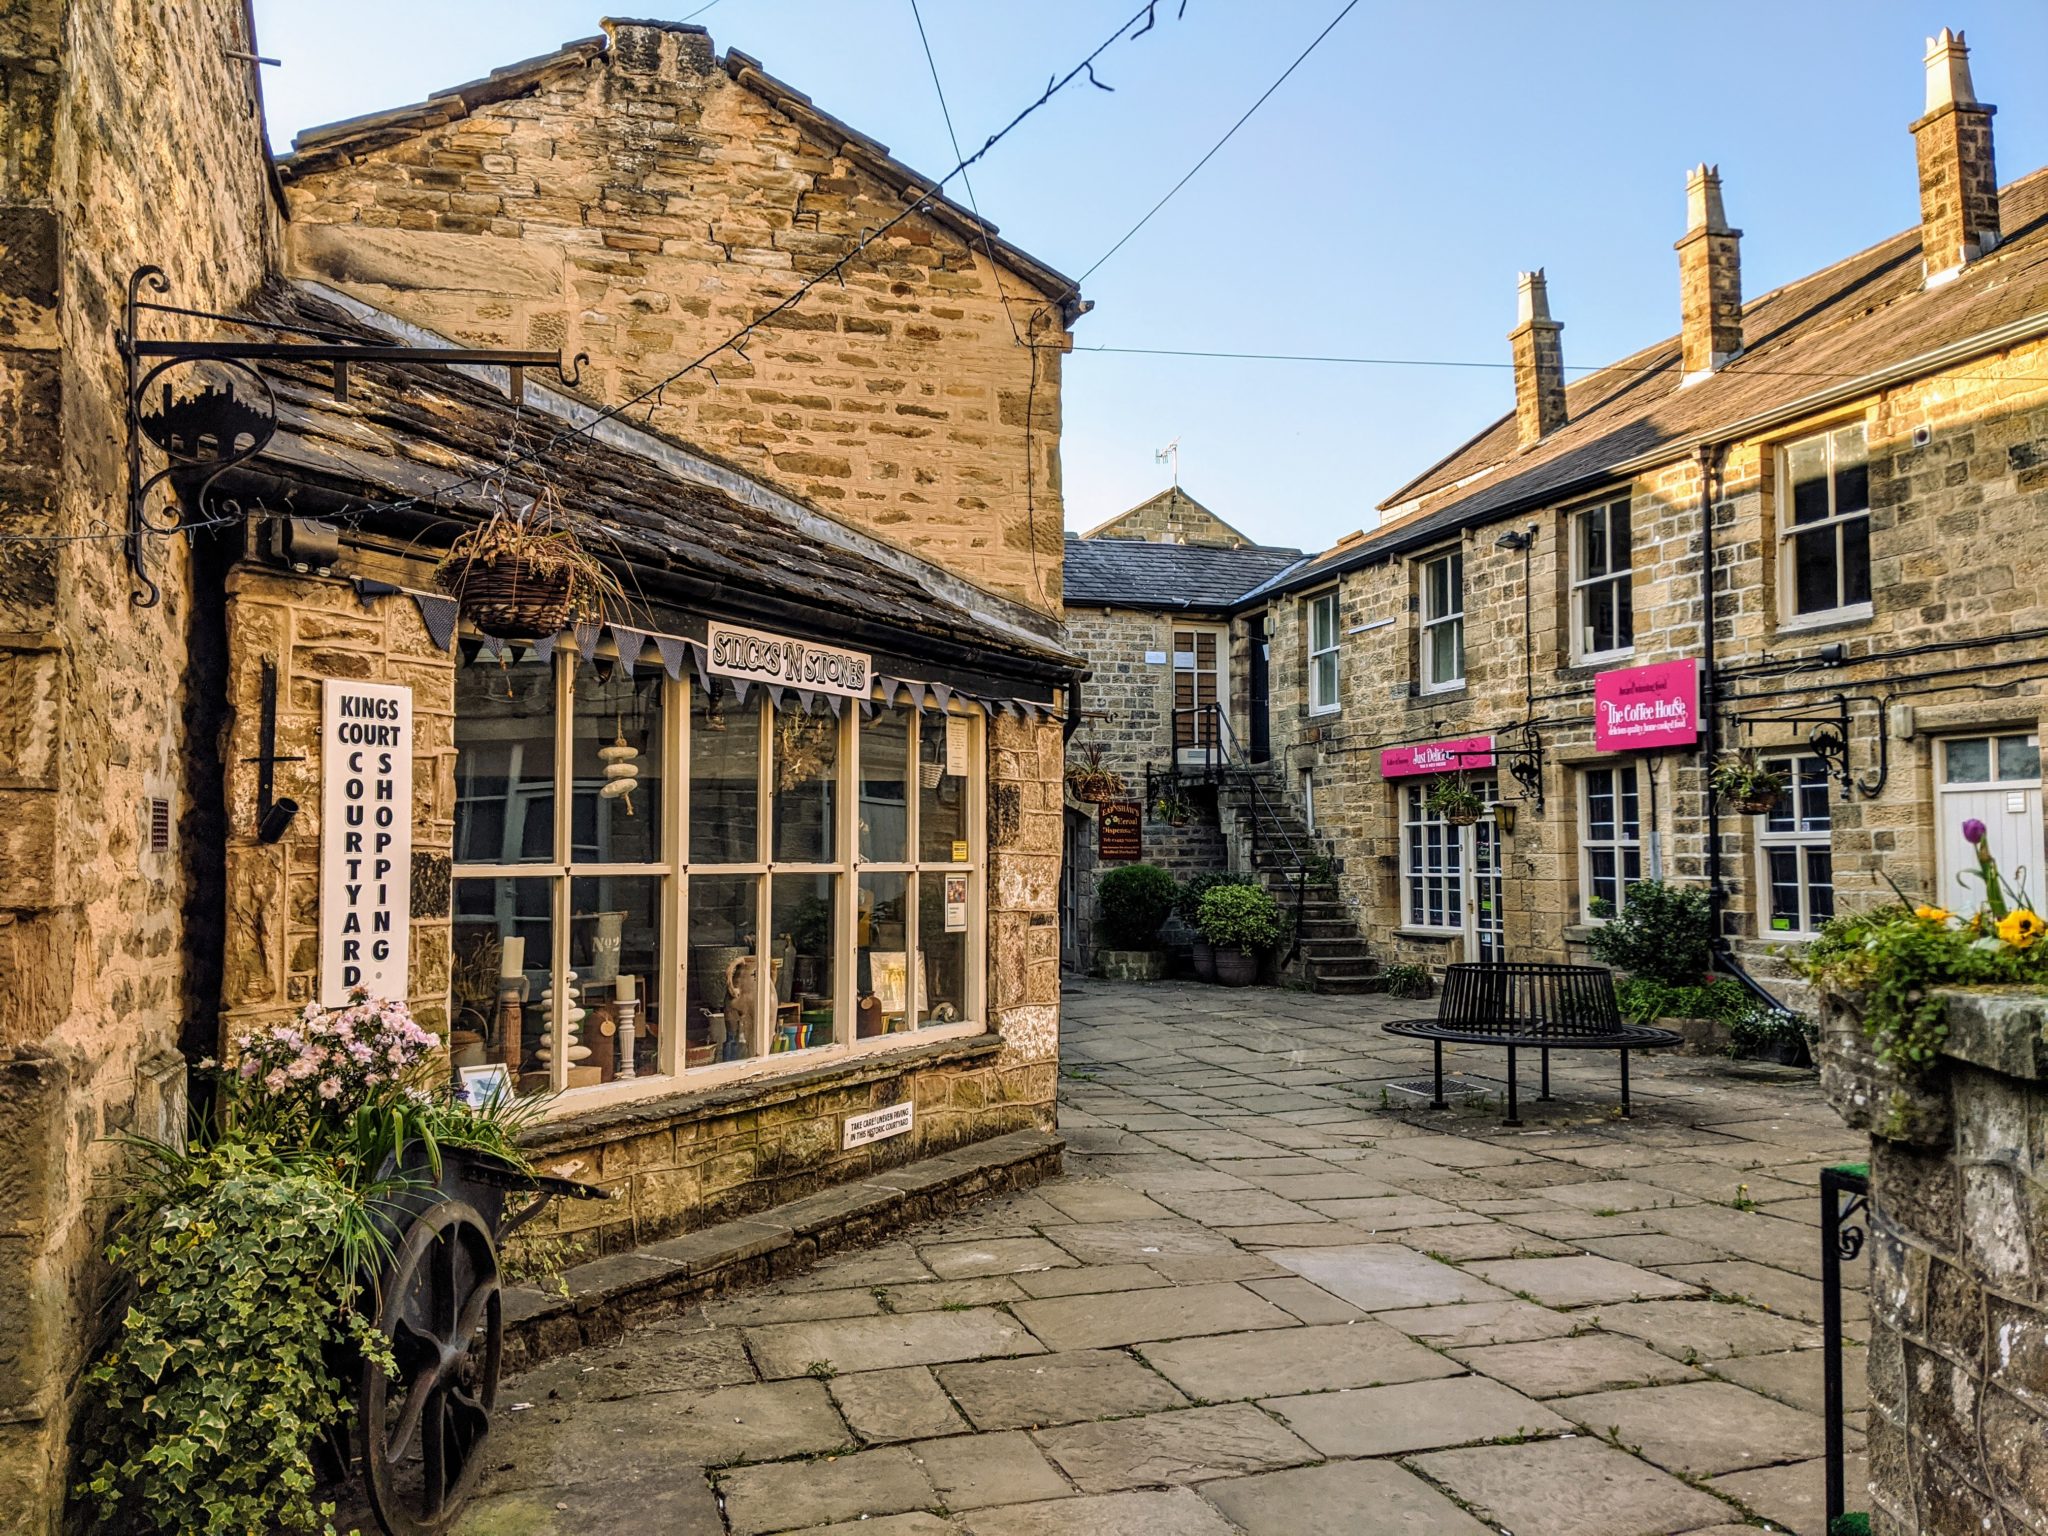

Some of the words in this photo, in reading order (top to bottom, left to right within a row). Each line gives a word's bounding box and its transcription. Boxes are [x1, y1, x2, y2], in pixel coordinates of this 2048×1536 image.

[713, 631, 781, 676] STICKS
[804, 650, 865, 690] STONES
[339, 695, 399, 721] KINGS
[1600, 700, 1624, 725] The
[1623, 702, 1654, 722] Coffee
[1655, 697, 1688, 719] House
[338, 722, 401, 747] COURT
[1413, 747, 1427, 764] Just
[341, 751, 364, 988] COURTYARD
[372, 753, 393, 961] SHOPPING
[850, 1120, 862, 1131] TAKE
[863, 1116, 876, 1127] CARE!
[876, 1112, 893, 1124] UNEVEN
[893, 1108, 909, 1119] PAVING
[850, 1133, 856, 1141] IN
[856, 1130, 866, 1139] THIS
[867, 1124, 886, 1138] HISTORIC
[885, 1117, 909, 1130] COURTYARD
